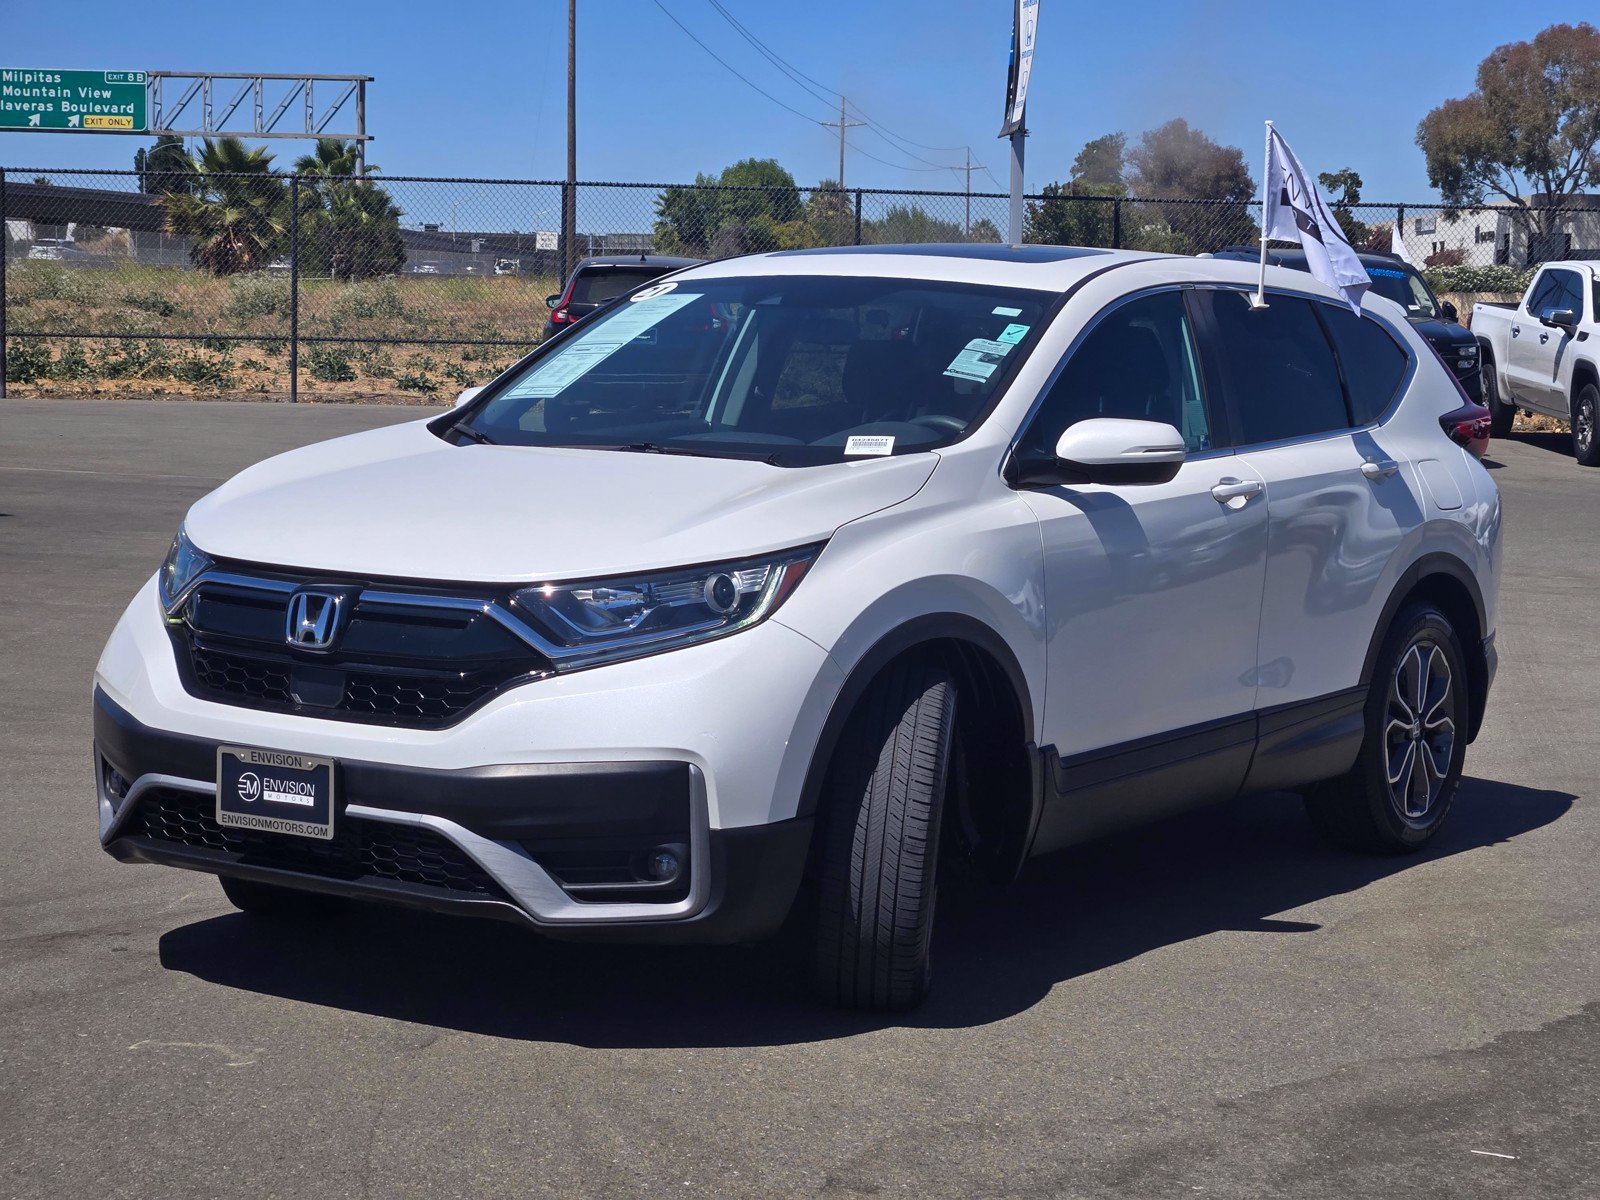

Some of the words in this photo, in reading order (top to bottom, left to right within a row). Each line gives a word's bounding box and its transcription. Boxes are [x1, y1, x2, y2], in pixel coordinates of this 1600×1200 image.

[2, 71, 61, 84] Milpitas
[2, 85, 71, 98] Mountain
[78, 87, 112, 99] View
[0, 100, 54, 111] laveras
[61, 101, 134, 113] Boulevard
[84, 118, 104, 126] EXIT
[250, 751, 302, 767] ENVISION
[263, 777, 315, 796] ENVISION
[267, 792, 311, 804] MOTORS
[221, 813, 328, 837] ENVISIONMOTORS.COM
